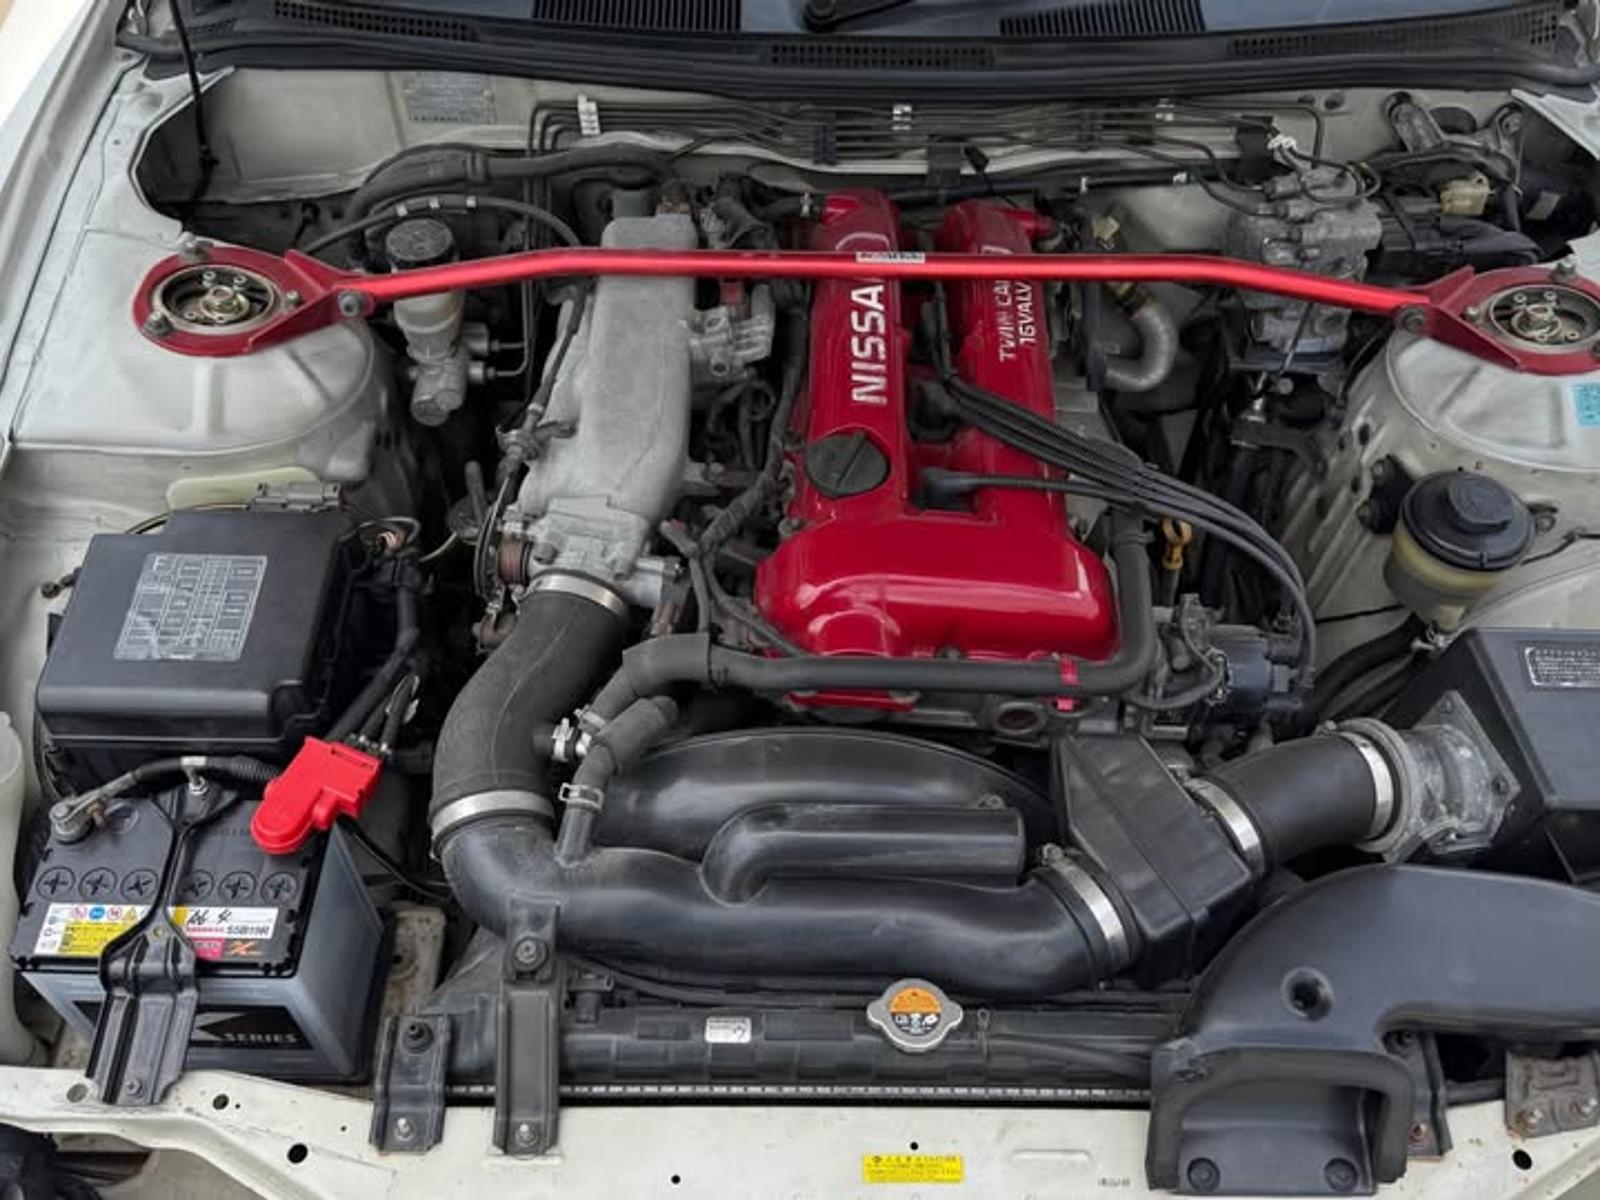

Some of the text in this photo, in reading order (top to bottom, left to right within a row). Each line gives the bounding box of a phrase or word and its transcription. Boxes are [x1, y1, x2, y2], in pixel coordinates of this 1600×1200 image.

[850, 276, 887, 406] NISSA
[993, 280, 1017, 363] TWIN CA
[1015, 281, 1037, 347] 16VALV
[223, 1032, 298, 1044] SERIES
